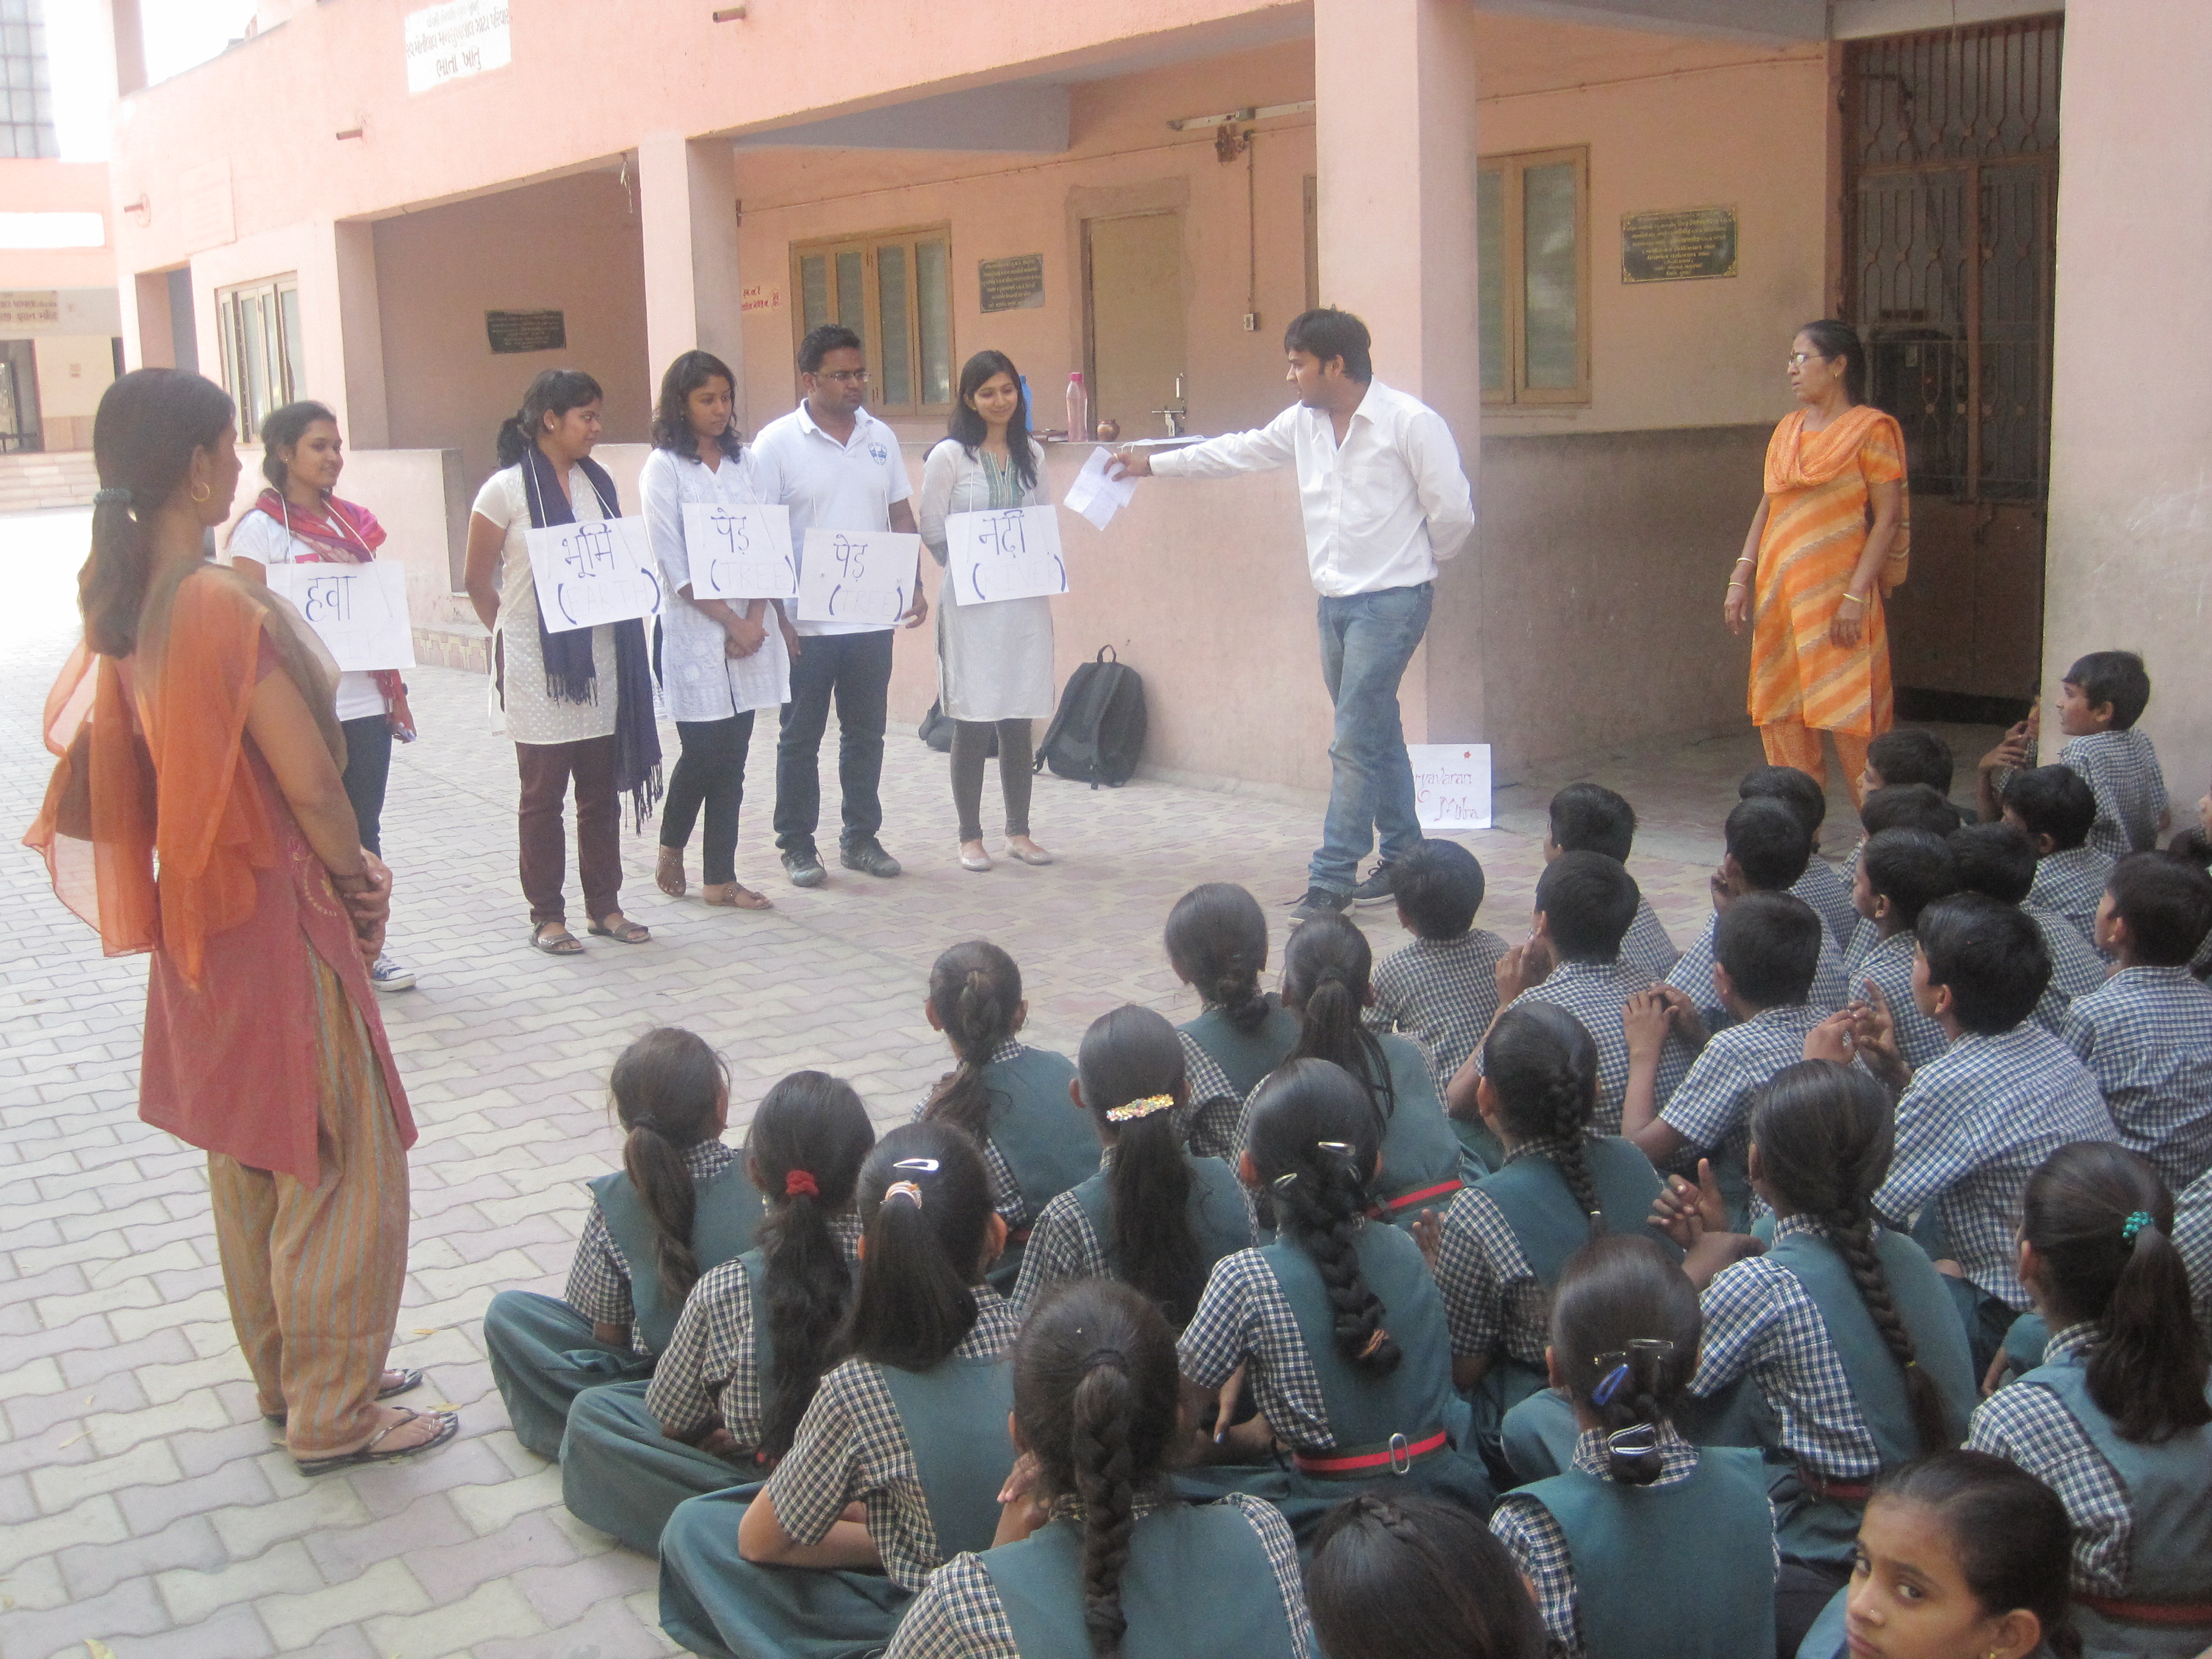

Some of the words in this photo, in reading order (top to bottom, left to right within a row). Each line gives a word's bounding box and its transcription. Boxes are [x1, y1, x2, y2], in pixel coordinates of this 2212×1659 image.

[436, 53, 459, 78] ભાતા
[561, 522, 612, 579] भूमि
[710, 507, 750, 555] पेड़
[979, 509, 1026, 558] नदी
[833, 534, 868, 582] पेड़
[305, 575, 358, 622] हवा
